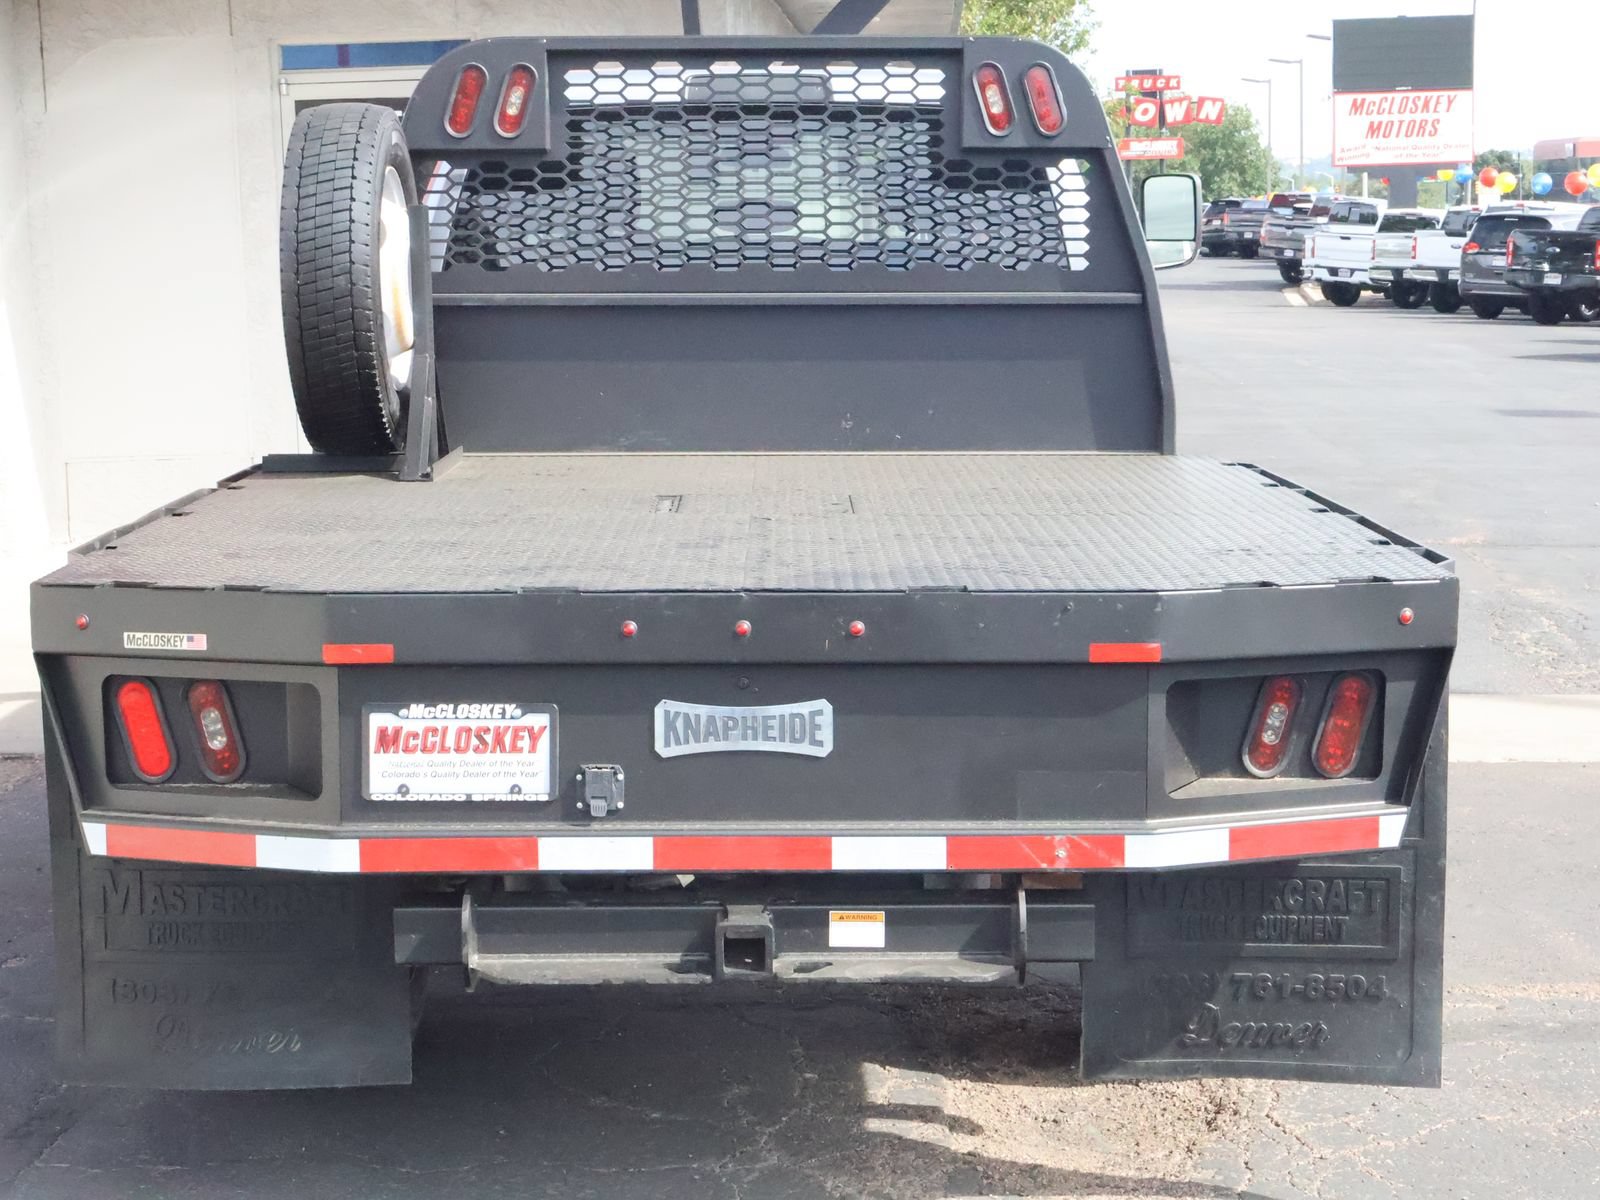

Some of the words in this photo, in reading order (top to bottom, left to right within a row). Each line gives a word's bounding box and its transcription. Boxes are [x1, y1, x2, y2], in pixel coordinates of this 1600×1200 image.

[1132, 99, 1222, 123] OWN
[1349, 94, 1457, 116] McCLOSKEY
[1365, 118, 1440, 139] MOTORS
[126, 633, 185, 648] McCLOSKEY
[407, 703, 517, 719] McCLOSKEY
[663, 709, 824, 748] KNAPHEIDE
[373, 725, 548, 755] McCLOSKEY
[427, 760, 457, 769] Quality
[459, 760, 486, 768] Dealer
[489, 760, 498, 768] of
[500, 760, 514, 768] the
[430, 770, 460, 780] Quality
[462, 770, 490, 778] Dealer
[492, 770, 501, 778] of
[503, 770, 517, 778] the
[370, 793, 467, 801] COLORADO
[471, 793, 549, 801] SPRINGS
